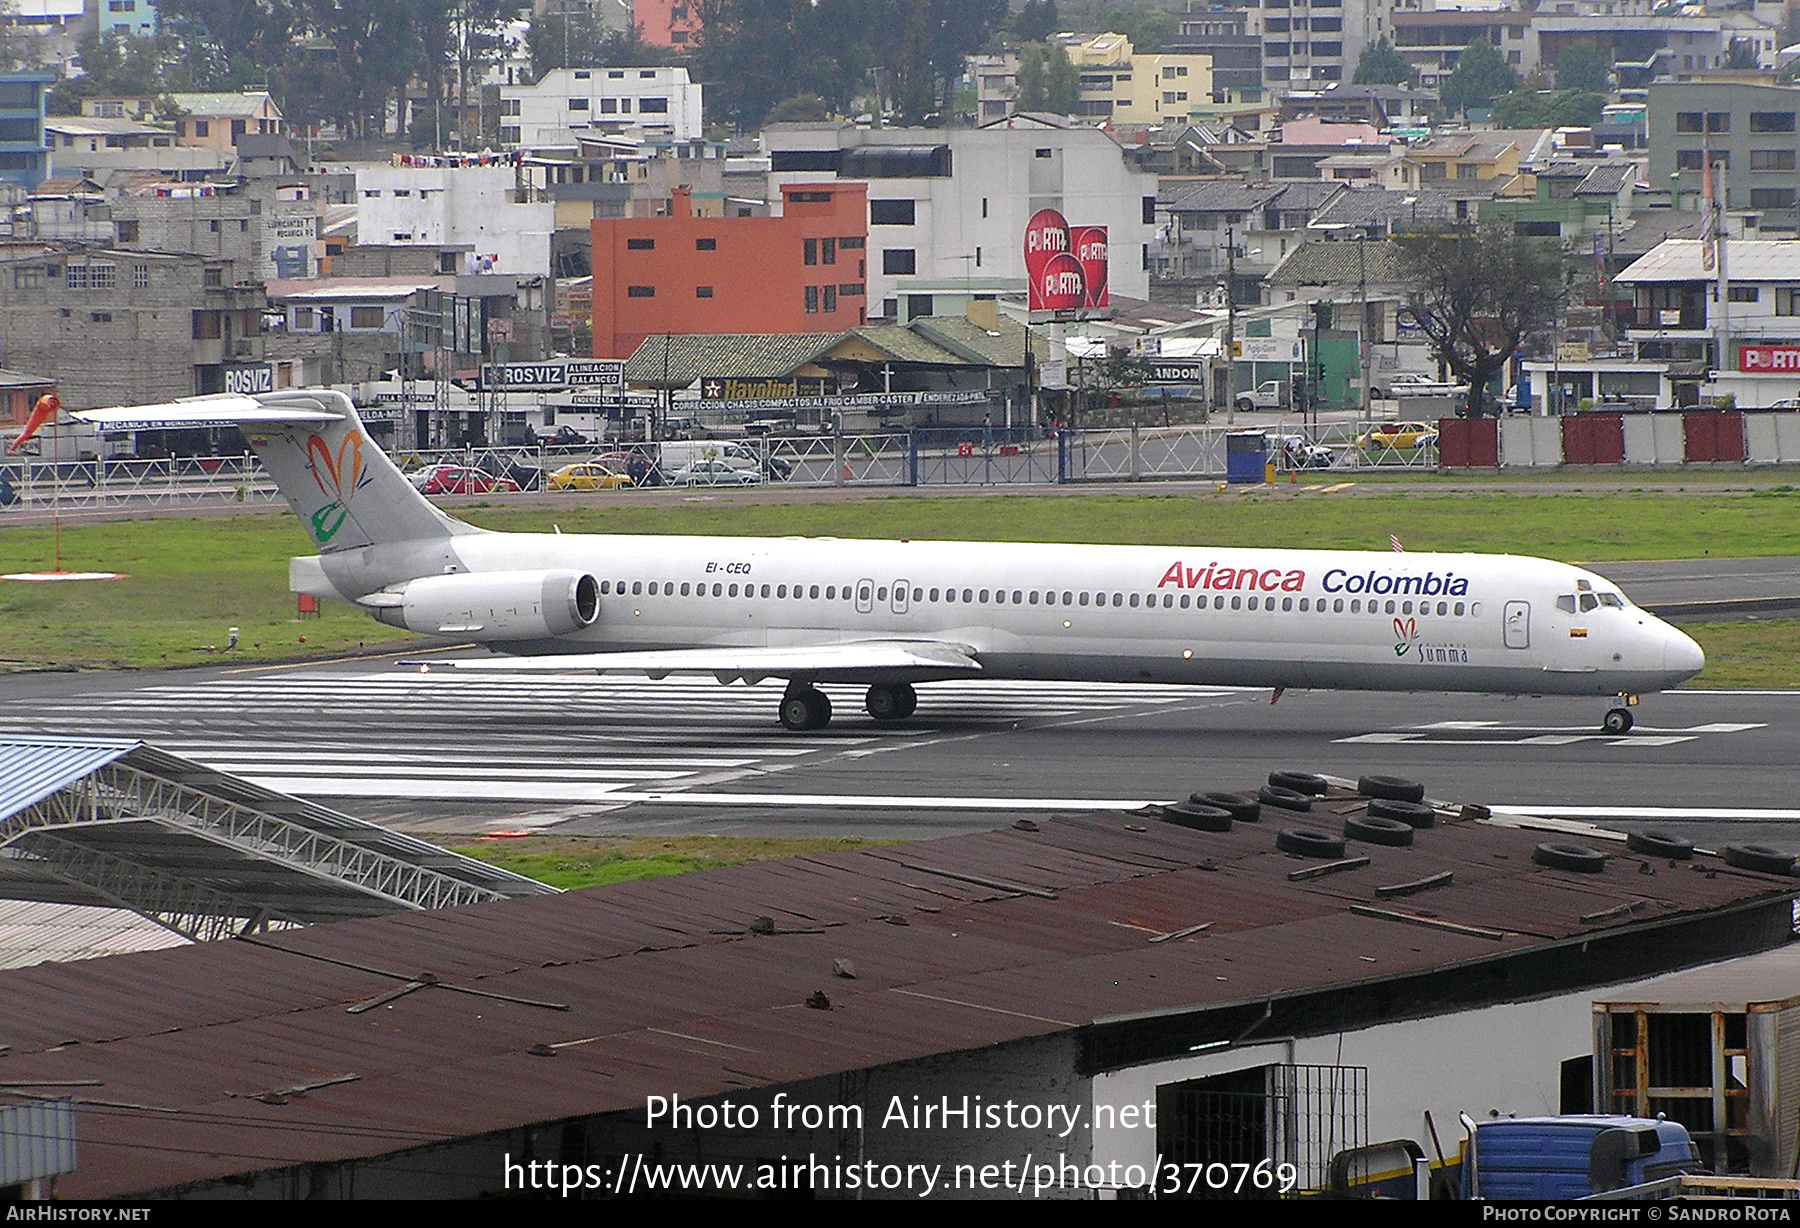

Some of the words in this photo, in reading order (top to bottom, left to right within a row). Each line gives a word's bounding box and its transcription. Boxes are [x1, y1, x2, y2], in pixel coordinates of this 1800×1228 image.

[1029, 227, 1067, 253] PORTA
[1046, 272, 1083, 297] PORTA
[569, 363, 619, 373] ALINEACION
[1746, 350, 1800, 368] PORT
[225, 368, 271, 394] ROSVIZ
[505, 367, 561, 383] ROSVIZ
[571, 375, 618, 384] BALANCEO
[1145, 368, 1199, 379] ANDON
[723, 379, 796, 400] Havoline
[672, 400, 726, 410] CORRECCION
[726, 399, 758, 410] CHASIS
[759, 398, 810, 408] COMPACTOS
[812, 397, 823, 407] AL
[824, 397, 842, 406] FRIO
[1158, 561, 1305, 592] Avianca
[1322, 569, 1468, 596] Colombia
[1419, 644, 1468, 663] Summa
